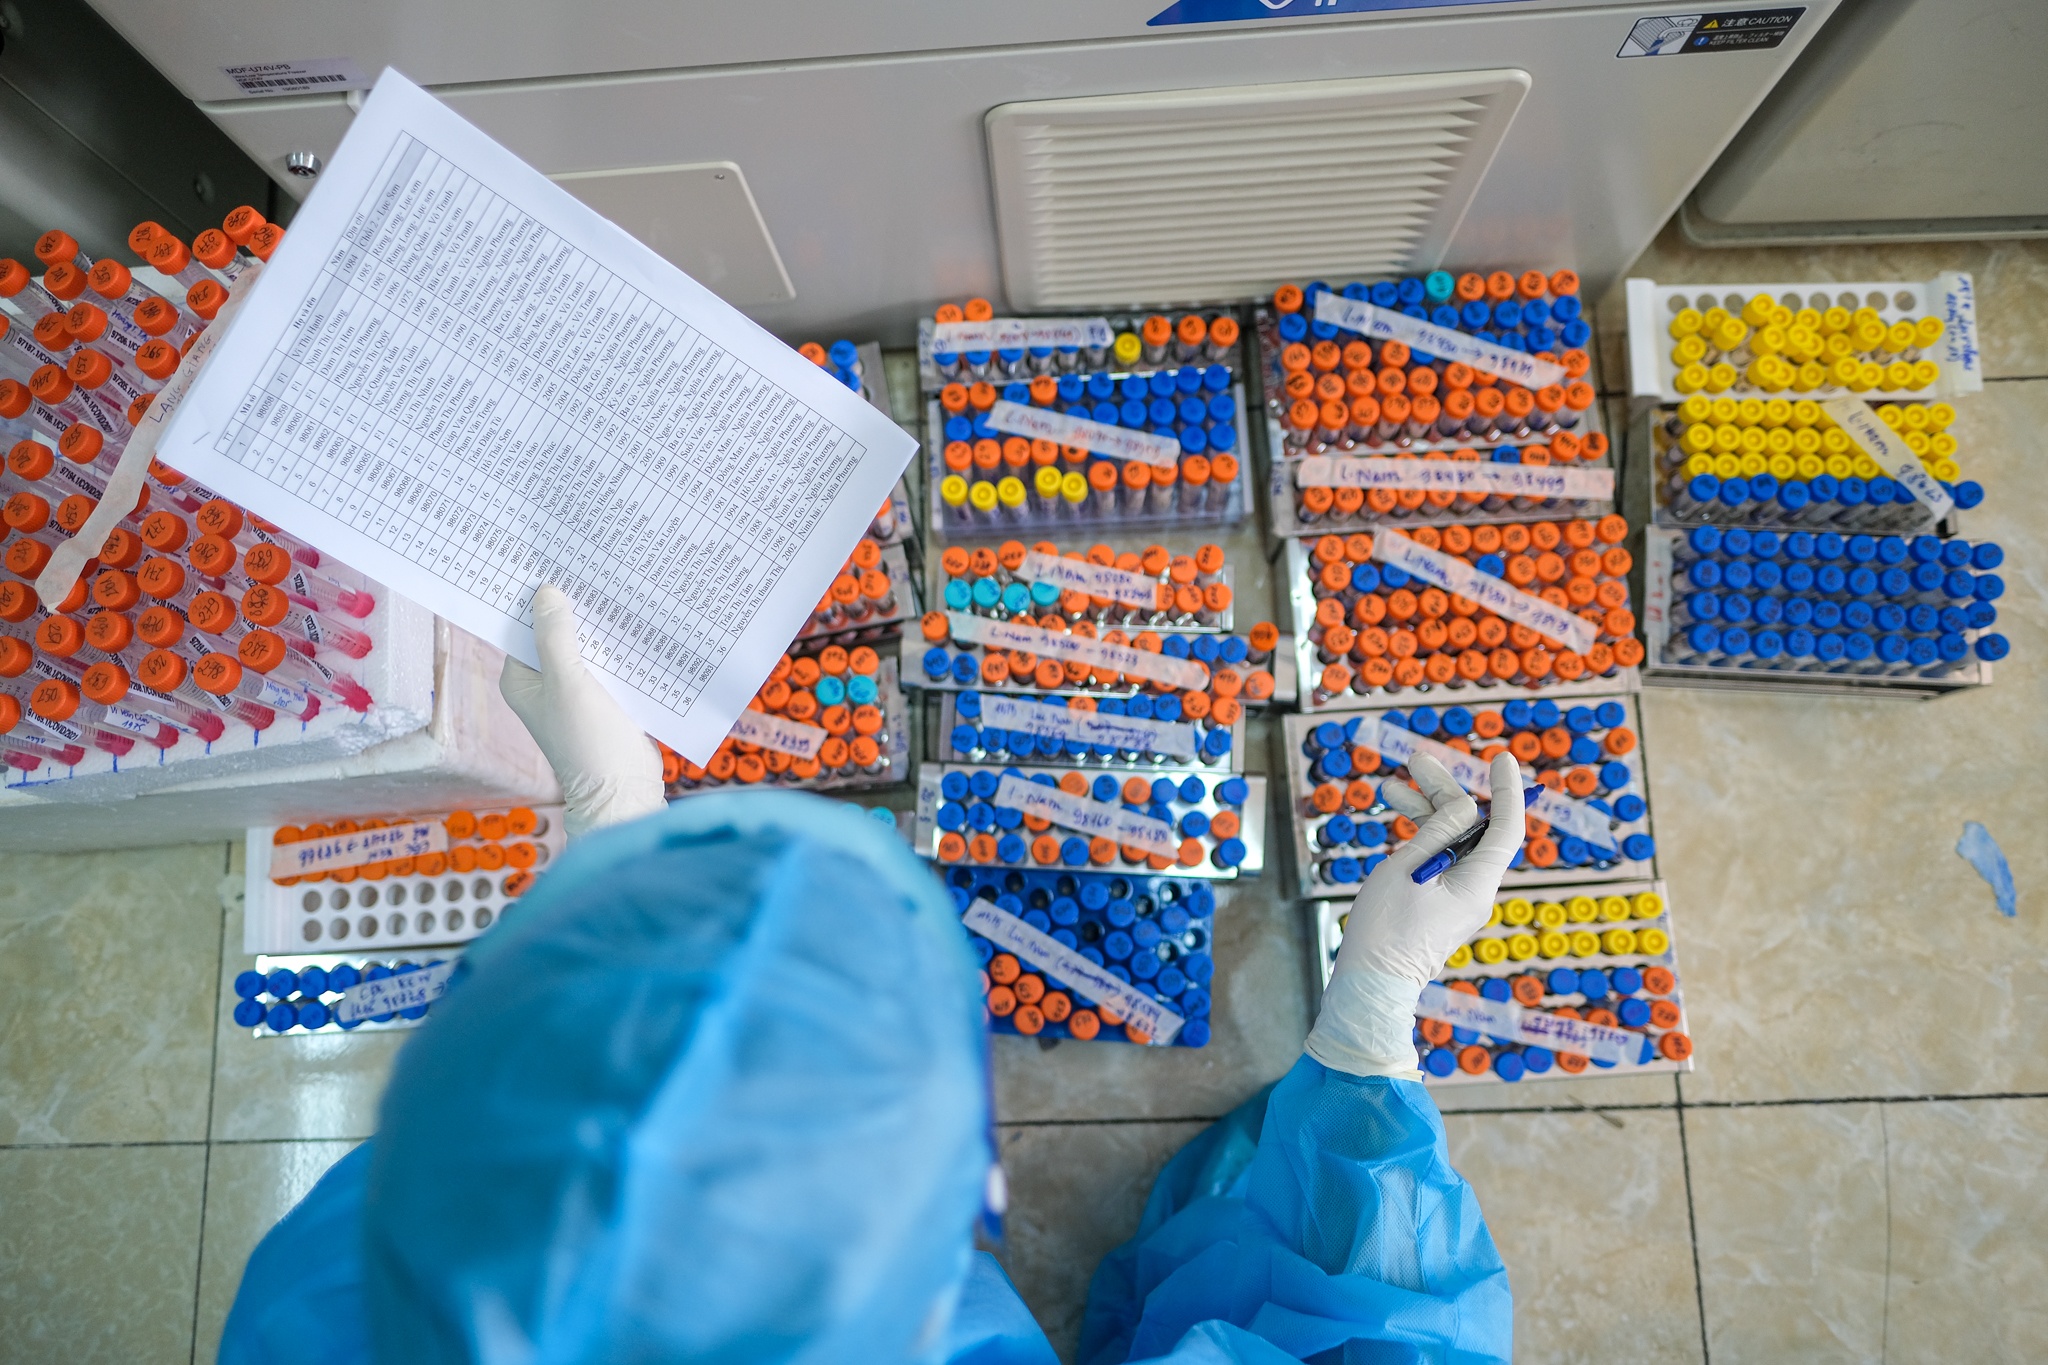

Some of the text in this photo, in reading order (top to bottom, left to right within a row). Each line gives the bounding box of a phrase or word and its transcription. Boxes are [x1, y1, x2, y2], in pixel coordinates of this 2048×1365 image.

[1721, 17, 1749, 28] 注意
[1748, 15, 1793, 26] CAUTION
[1748, 36, 1768, 44] CLEAN
[292, 316, 305, 330] Họ
[298, 307, 309, 318] và
[303, 294, 316, 309] tên
[330, 247, 345, 267] Năm
[239, 403, 251, 415] Mã
[244, 392, 257, 406] số
[256, 253, 359, 418] 98058 1984
[270, 262, 372, 426] 98059 1985
[284, 271, 386, 435] 98060 1983
[298, 280, 400, 443] 98061 1986
[312, 288, 413, 450] 98062 1975
[326, 298, 426, 460] 98063 1990
[340, 305, 440, 467] 98064 1989
[353, 314, 454, 475] 98065 1981
[367, 322, 468, 483] 98066 1990
[420, 273, 570, 514] 98070 2003 Vô Tranh
[223, 431, 234, 442] TT
[380, 331, 480, 491] 98067 1991
[393, 339, 493, 498] 98068 1991
[407, 347, 506, 506] 98069 1995
[433, 364, 532, 521] 98071 2001
[446, 372, 545, 528] 98072 1999
[459, 380, 558, 536] 98073 2005
[472, 389, 570, 543] 98074 2004
[484, 312, 638, 551] 98075 1992 Nghĩa Phương
[497, 405, 595, 558] 98076 1990
[534, 359, 679, 579] 98079 1995 Nghĩa Phương
[627, 439, 643, 459] 2001
[639, 447, 656, 468] 2002
[510, 414, 607, 565] 98077 1982
[522, 422, 620, 572] 98078 1992
[571, 454, 667, 601] 98082 1989
[583, 463, 679, 609] 98083 1999
[595, 470, 691, 616] 98084 1999
[606, 478, 704, 624] 98085 1994
[618, 486, 715, 631] 98086 1999
[652, 418, 815, 654] 98089 1994 Nghĩa Phương
[687, 453, 843, 676] 98092 1986 Nghĩa Phương
[630, 495, 728, 639] 98087 1981
[641, 502, 740, 646] 98088 1994
[664, 517, 763, 661] 98090 1988
[675, 525, 775, 668] 98091 1988
[698, 541, 798, 683] 98093 2002
[121, 720, 146, 733] 1975
